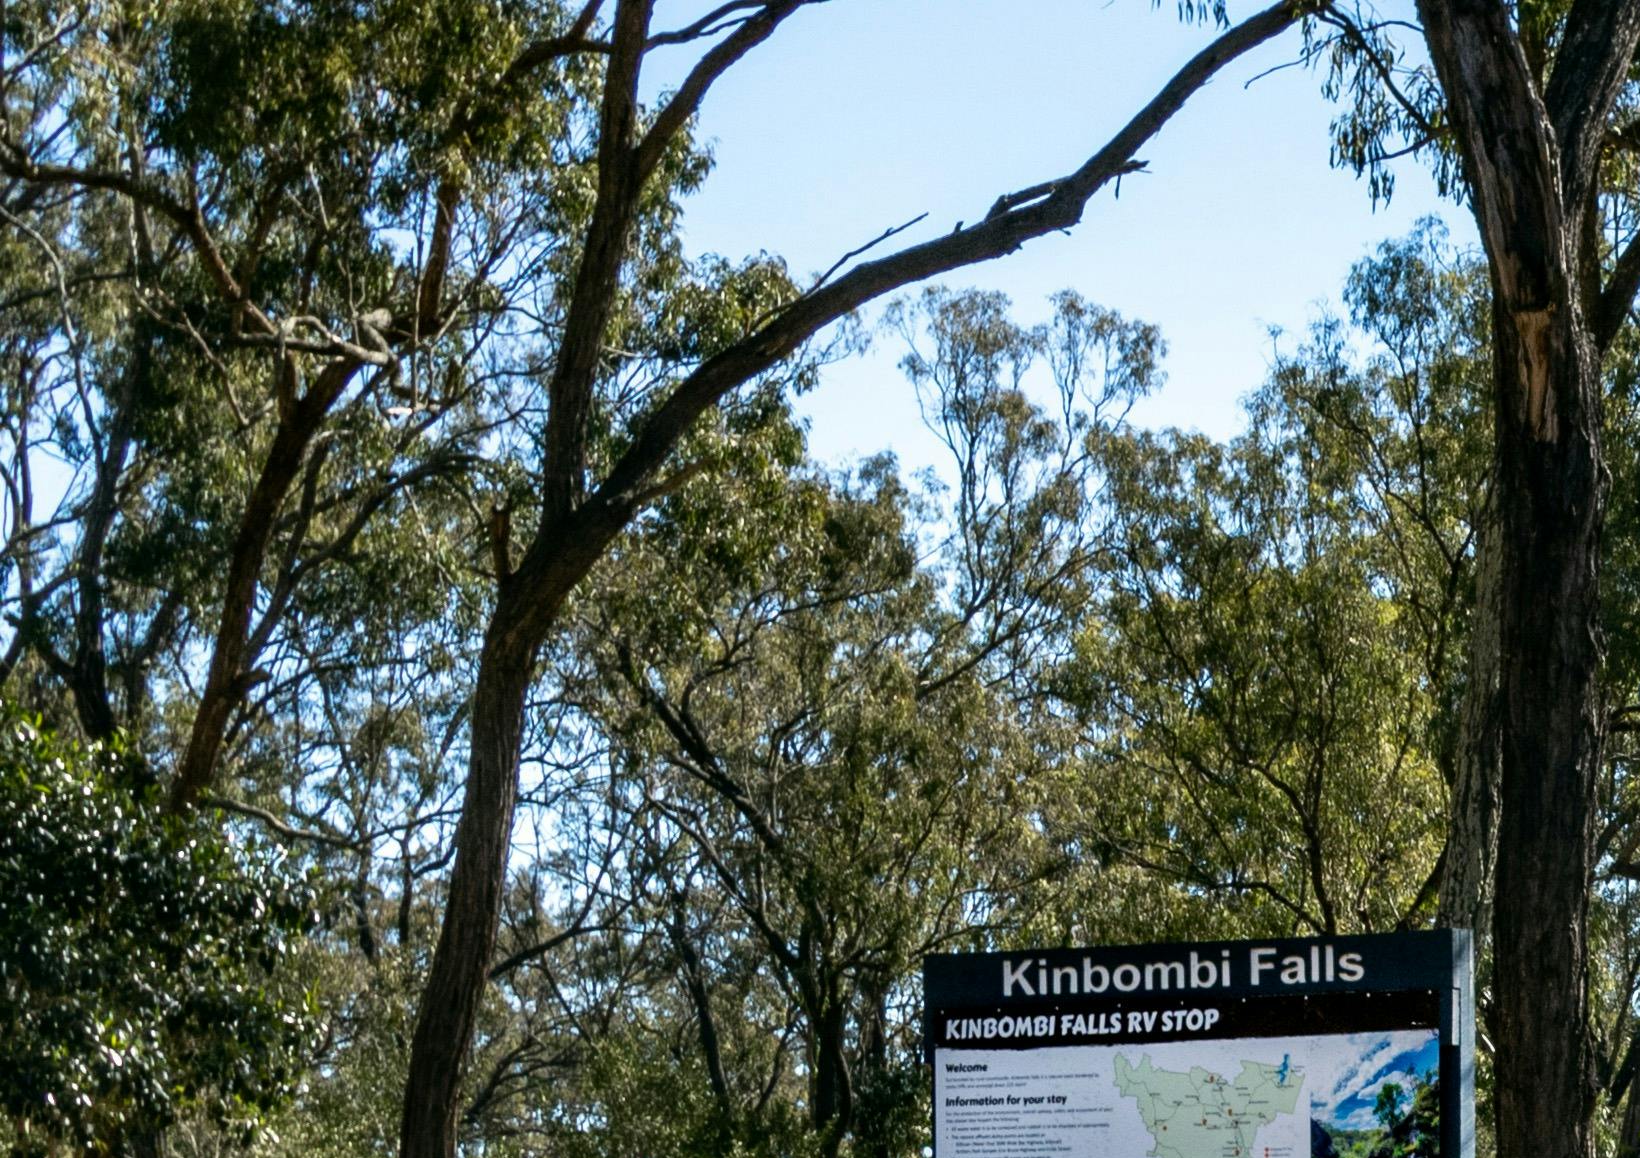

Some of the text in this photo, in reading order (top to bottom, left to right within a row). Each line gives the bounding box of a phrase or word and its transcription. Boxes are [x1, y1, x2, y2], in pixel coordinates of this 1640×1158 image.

[1002, 944, 1366, 997] Kinbombi Falls
[945, 1008, 1220, 1041] KINBOMBI FALLS RV STOP
[945, 1063, 988, 1073] Welcome
[945, 1094, 1067, 1107] Information for your stay
